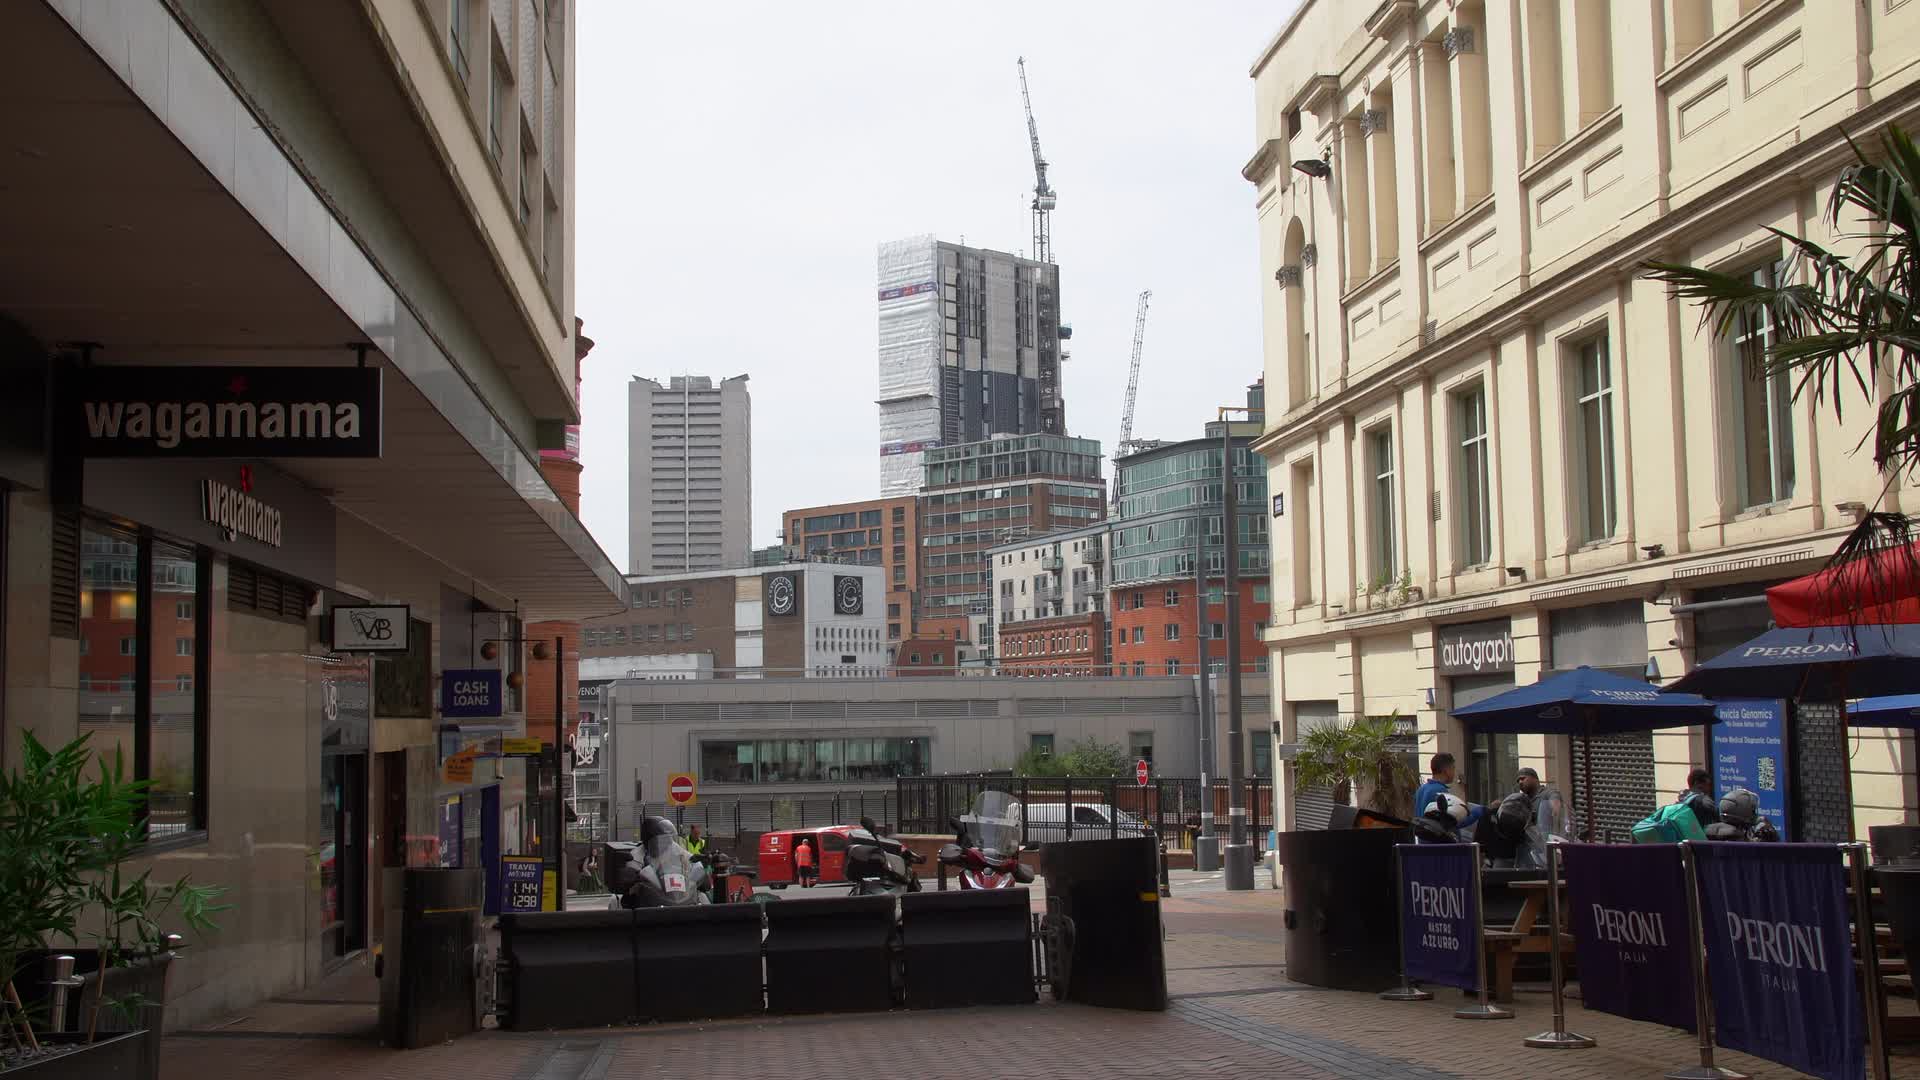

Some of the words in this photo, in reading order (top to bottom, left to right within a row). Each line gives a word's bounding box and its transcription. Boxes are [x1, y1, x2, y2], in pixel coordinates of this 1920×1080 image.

[84, 400, 361, 449] wagamama
[207, 480, 281, 549] wagamama
[1443, 631, 1514, 671] autograph
[453, 681, 489, 694] CASH
[453, 695, 489, 707] LOANS
[1719, 708, 1740, 719] Invicta
[1741, 707, 1773, 719] Genomics
[509, 863, 537, 871] TRAVEL
[669, 877, 682, 887] L
[1410, 881, 1465, 920] PERONI
[1591, 903, 1669, 947] PERONI
[1422, 934, 1460, 951] AZZURRO
[1727, 911, 1835, 973] PERONI
